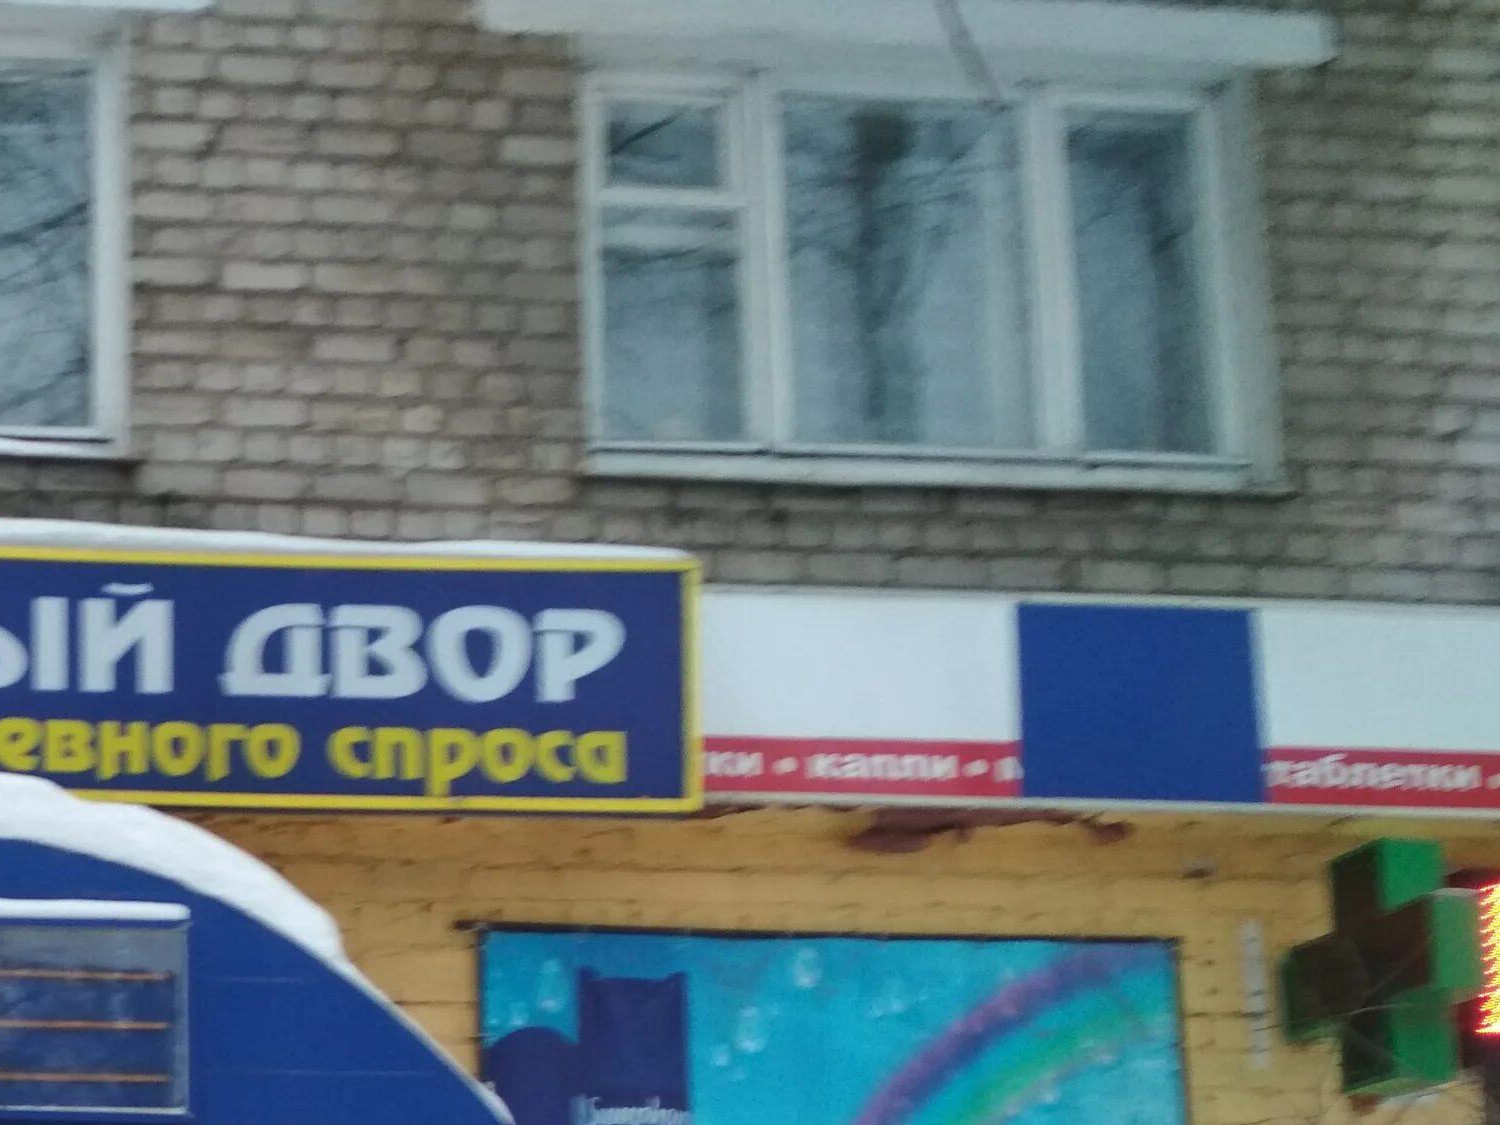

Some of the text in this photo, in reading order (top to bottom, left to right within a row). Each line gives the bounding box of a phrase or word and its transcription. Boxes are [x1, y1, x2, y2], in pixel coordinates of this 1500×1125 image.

[218, 601, 626, 704] ДВОР
[326, 725, 630, 797] спроса
[802, 752, 961, 782] капли
[1260, 752, 1484, 792] таблетки
